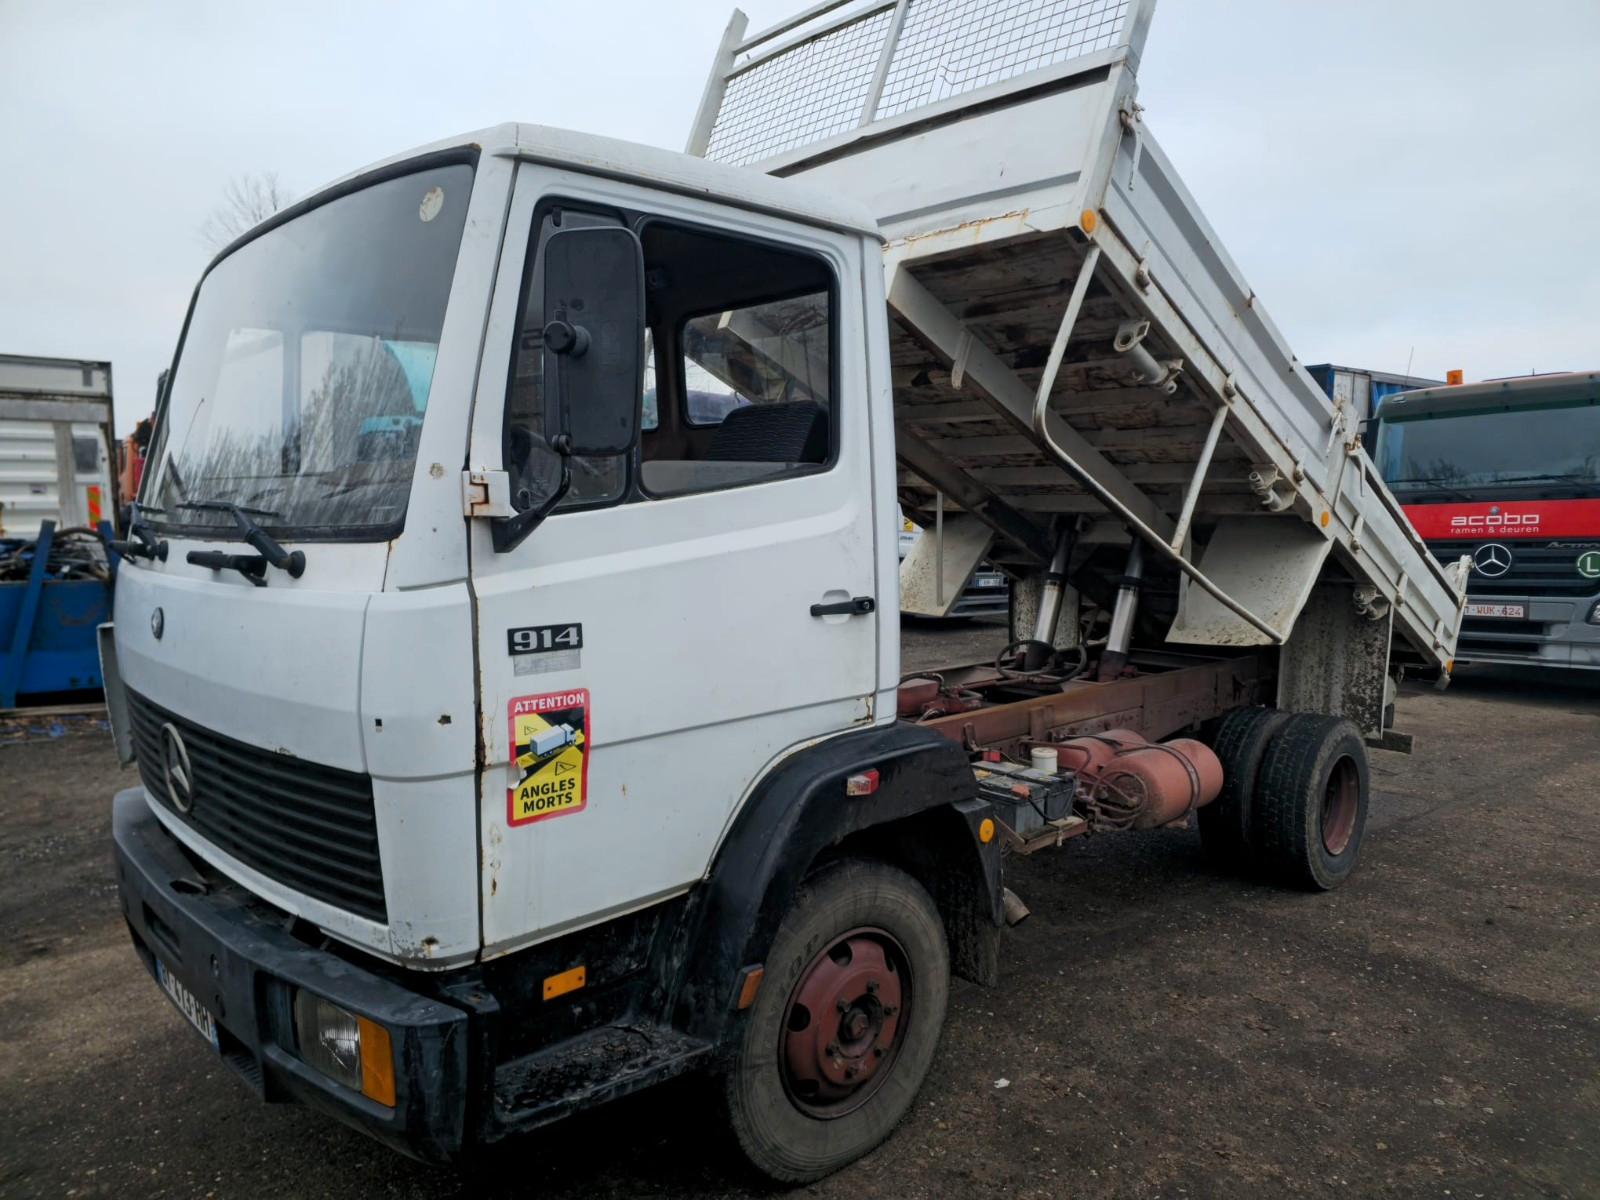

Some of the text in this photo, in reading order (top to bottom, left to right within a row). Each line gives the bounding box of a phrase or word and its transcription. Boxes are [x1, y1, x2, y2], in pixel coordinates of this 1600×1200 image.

[1451, 512, 1539, 526] acobo
[1488, 526, 1495, 534] &
[1499, 525, 1539, 534] deuren
[1586, 556, 1599, 572] L
[513, 626, 580, 651] 914
[514, 692, 585, 713] ATTENTION
[520, 777, 576, 801] ANGLES
[523, 791, 573, 814] MORTS
